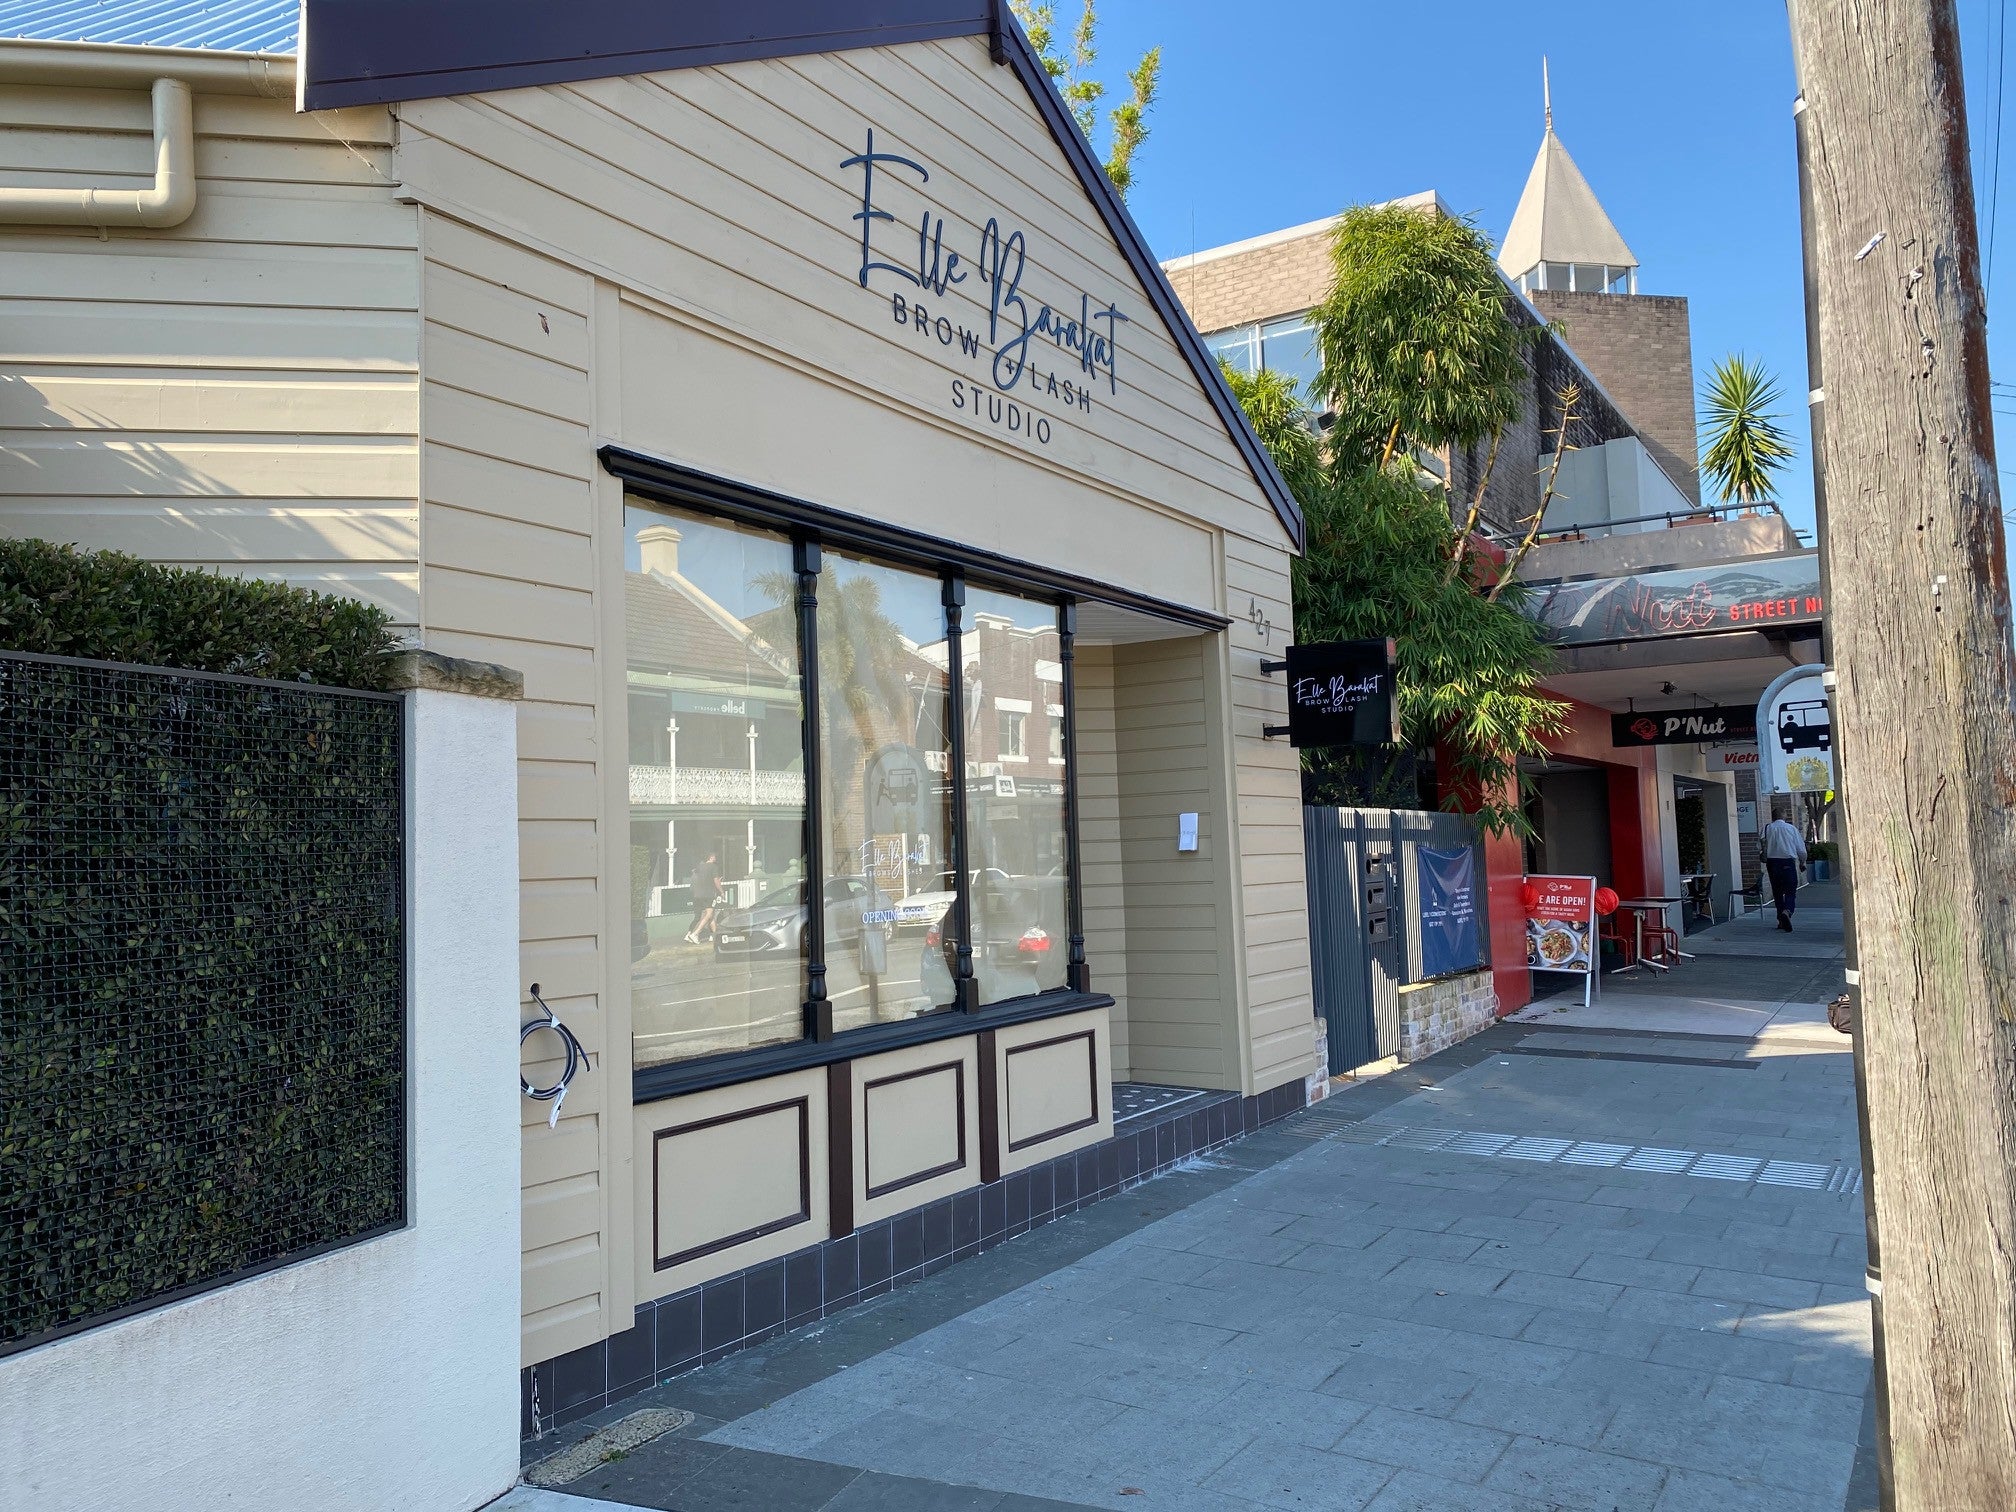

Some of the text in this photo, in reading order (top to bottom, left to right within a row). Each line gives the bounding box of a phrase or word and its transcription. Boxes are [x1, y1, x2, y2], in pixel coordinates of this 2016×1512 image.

[841, 127, 1130, 396] Elle Barakat
[893, 292, 980, 359] BROW
[1031, 362, 1091, 414] LASH
[951, 379, 1051, 444] STUDIO
[1248, 597, 1271, 647] 427
[1729, 597, 1798, 621] STREET
[1292, 674, 1384, 707] Elle Barakat
[1305, 695, 1368, 706] BROW LASH
[1321, 705, 1354, 714] STUDIO
[1663, 716, 1727, 737] P'Nut
[857, 838, 886, 874] Elle
[1545, 895, 1561, 905] ARE
[1562, 896, 1586, 906] OPEN!
